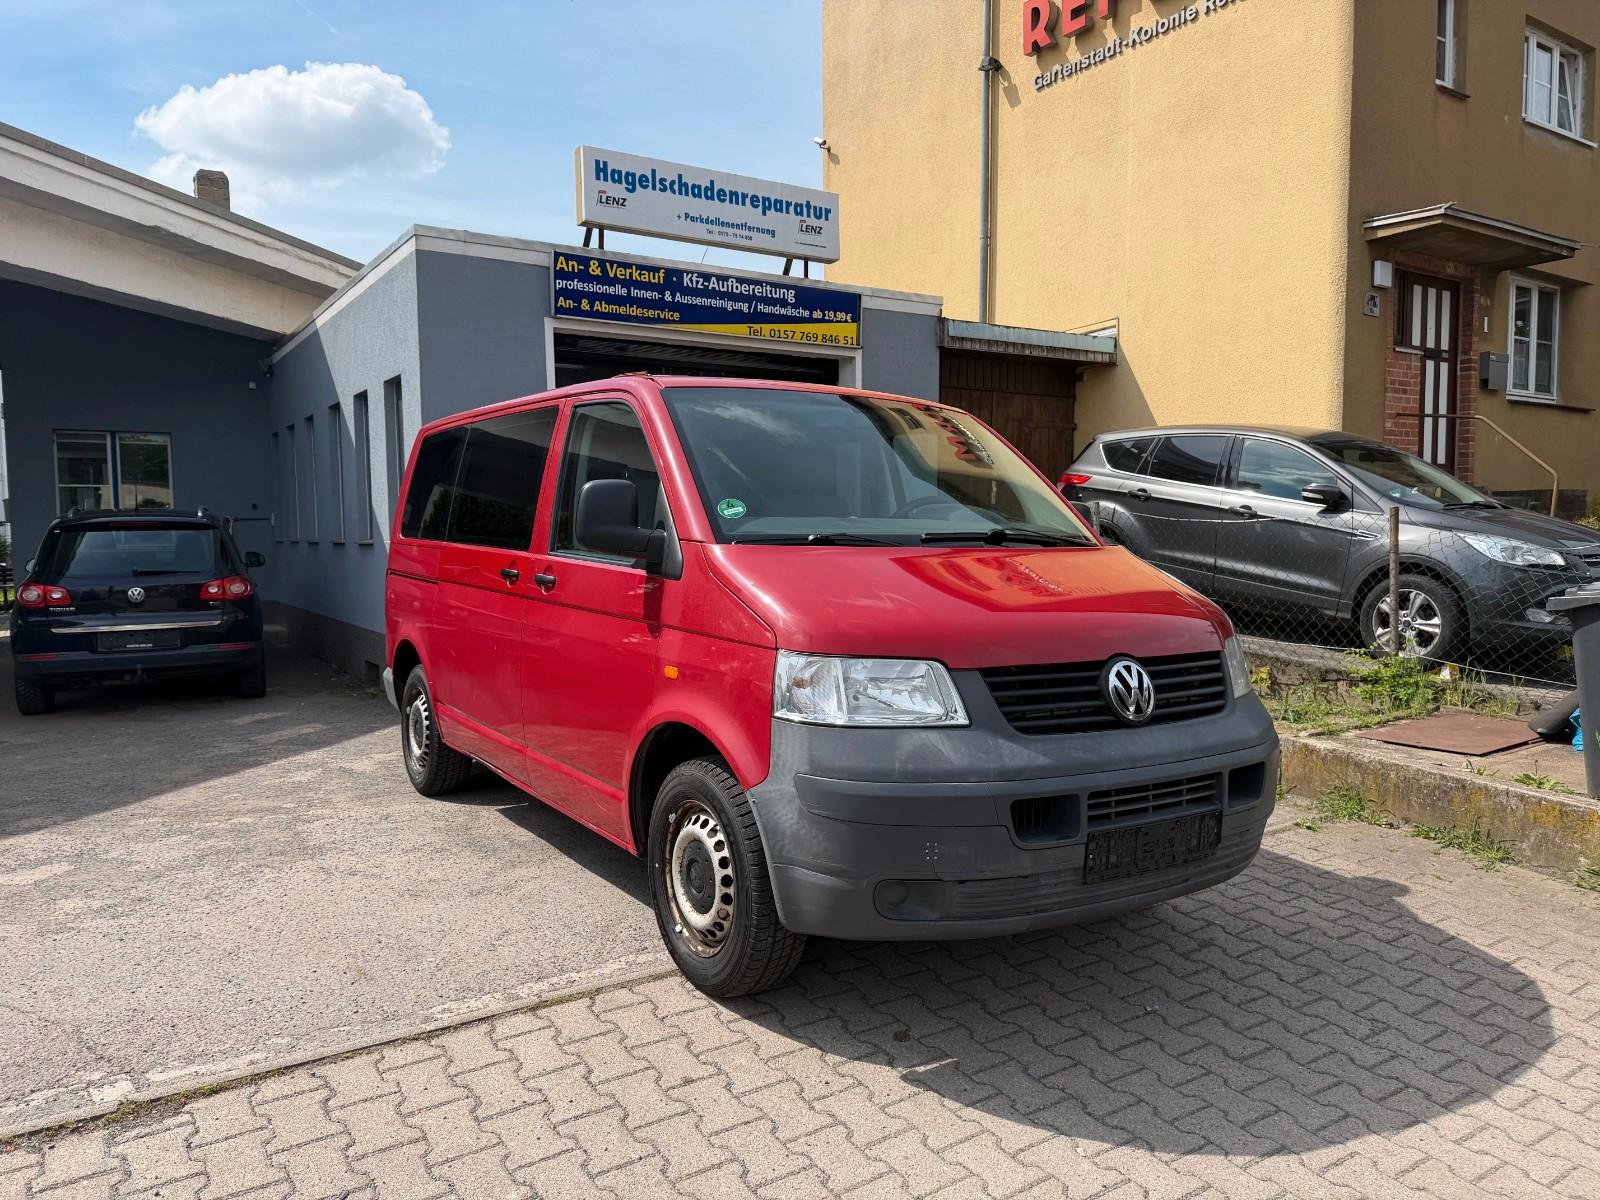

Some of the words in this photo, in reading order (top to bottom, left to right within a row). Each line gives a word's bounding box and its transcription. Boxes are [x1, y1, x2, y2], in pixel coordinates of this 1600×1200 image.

[1033, 7, 1197, 90] Gartenstadt-Kolonie
[595, 159, 832, 221] Hagelschadenreparatur
[600, 195, 627, 207] LENZ
[684, 212, 776, 239] Parkdellenentfernung
[800, 224, 823, 235] LENZ
[556, 255, 584, 272] An-
[589, 260, 602, 276] &
[606, 262, 665, 284] Verkauf
[683, 272, 796, 303] Kfz-Aufbereitung
[556, 278, 627, 296] professionelle
[631, 286, 662, 300] Innen-
[664, 290, 672, 302] &
[675, 292, 749, 313] Aussenreinigung
[750, 300, 756, 313] /
[757, 302, 810, 319] Handwäsche
[812, 309, 823, 320] ab
[557, 296, 578, 309] An-
[580, 298, 591, 311] &
[593, 300, 680, 321] Abmeldeservice
[747, 325, 766, 338] Tel.
[769, 328, 796, 340] 0157
[800, 331, 818, 343] 769
[821, 333, 840, 345] 846
[843, 334, 855, 346] 51
